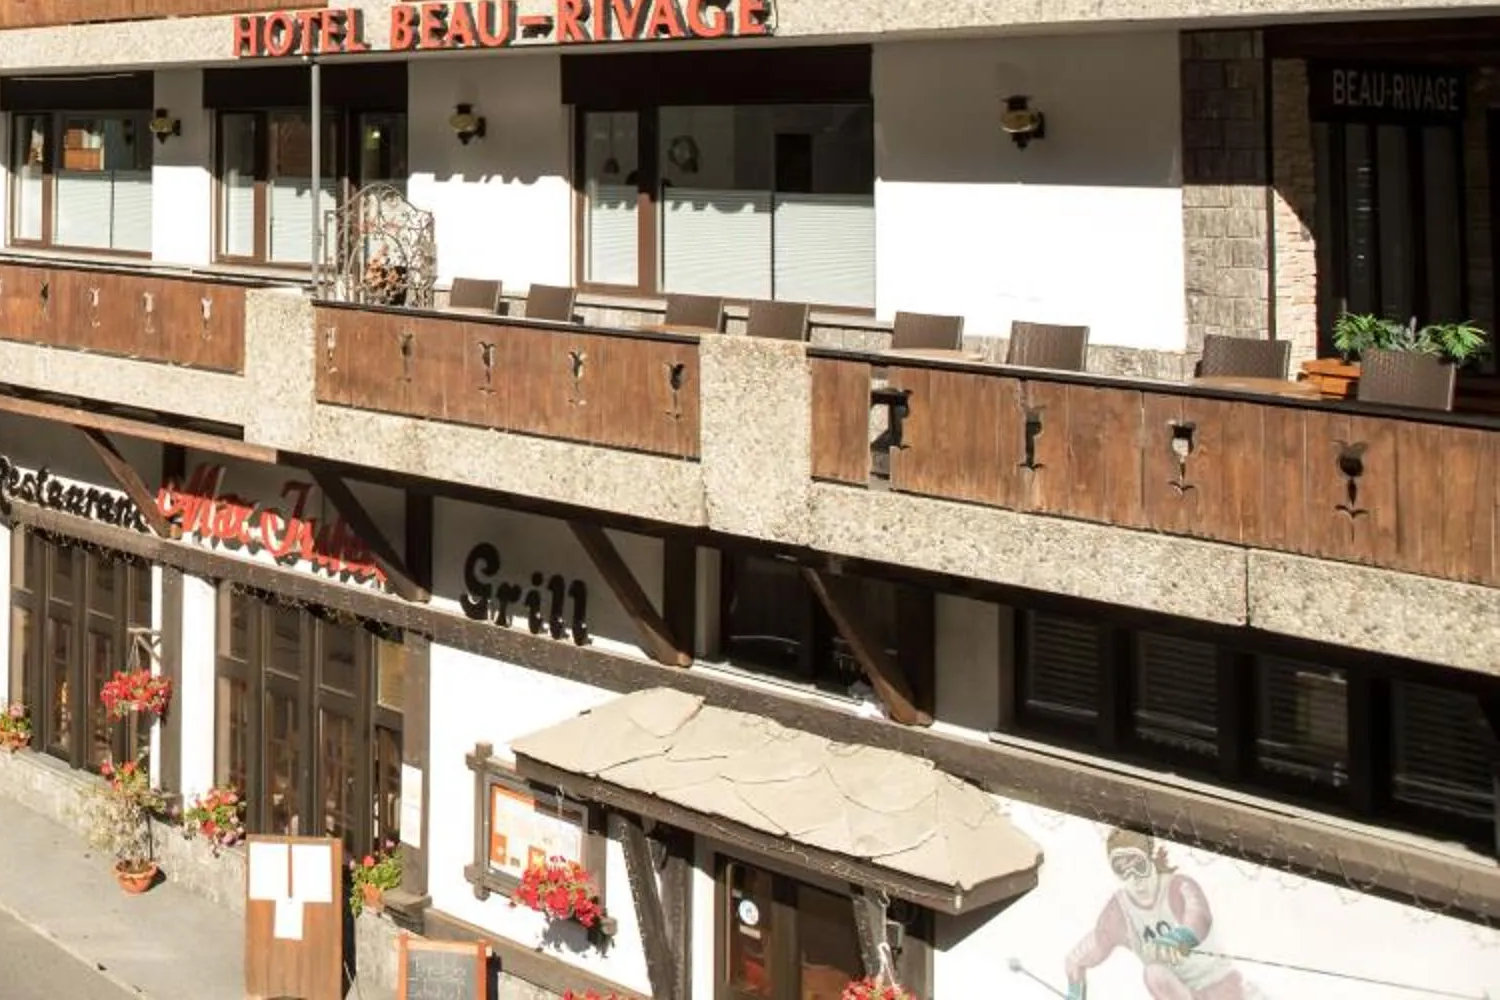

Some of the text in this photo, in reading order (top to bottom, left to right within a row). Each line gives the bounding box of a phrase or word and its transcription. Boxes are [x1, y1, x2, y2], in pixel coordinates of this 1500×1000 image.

[233, 8, 369, 57] HOTEL
[1332, 69, 1459, 111] BEAU-RIVAGE
[460, 542, 592, 646] Grill
